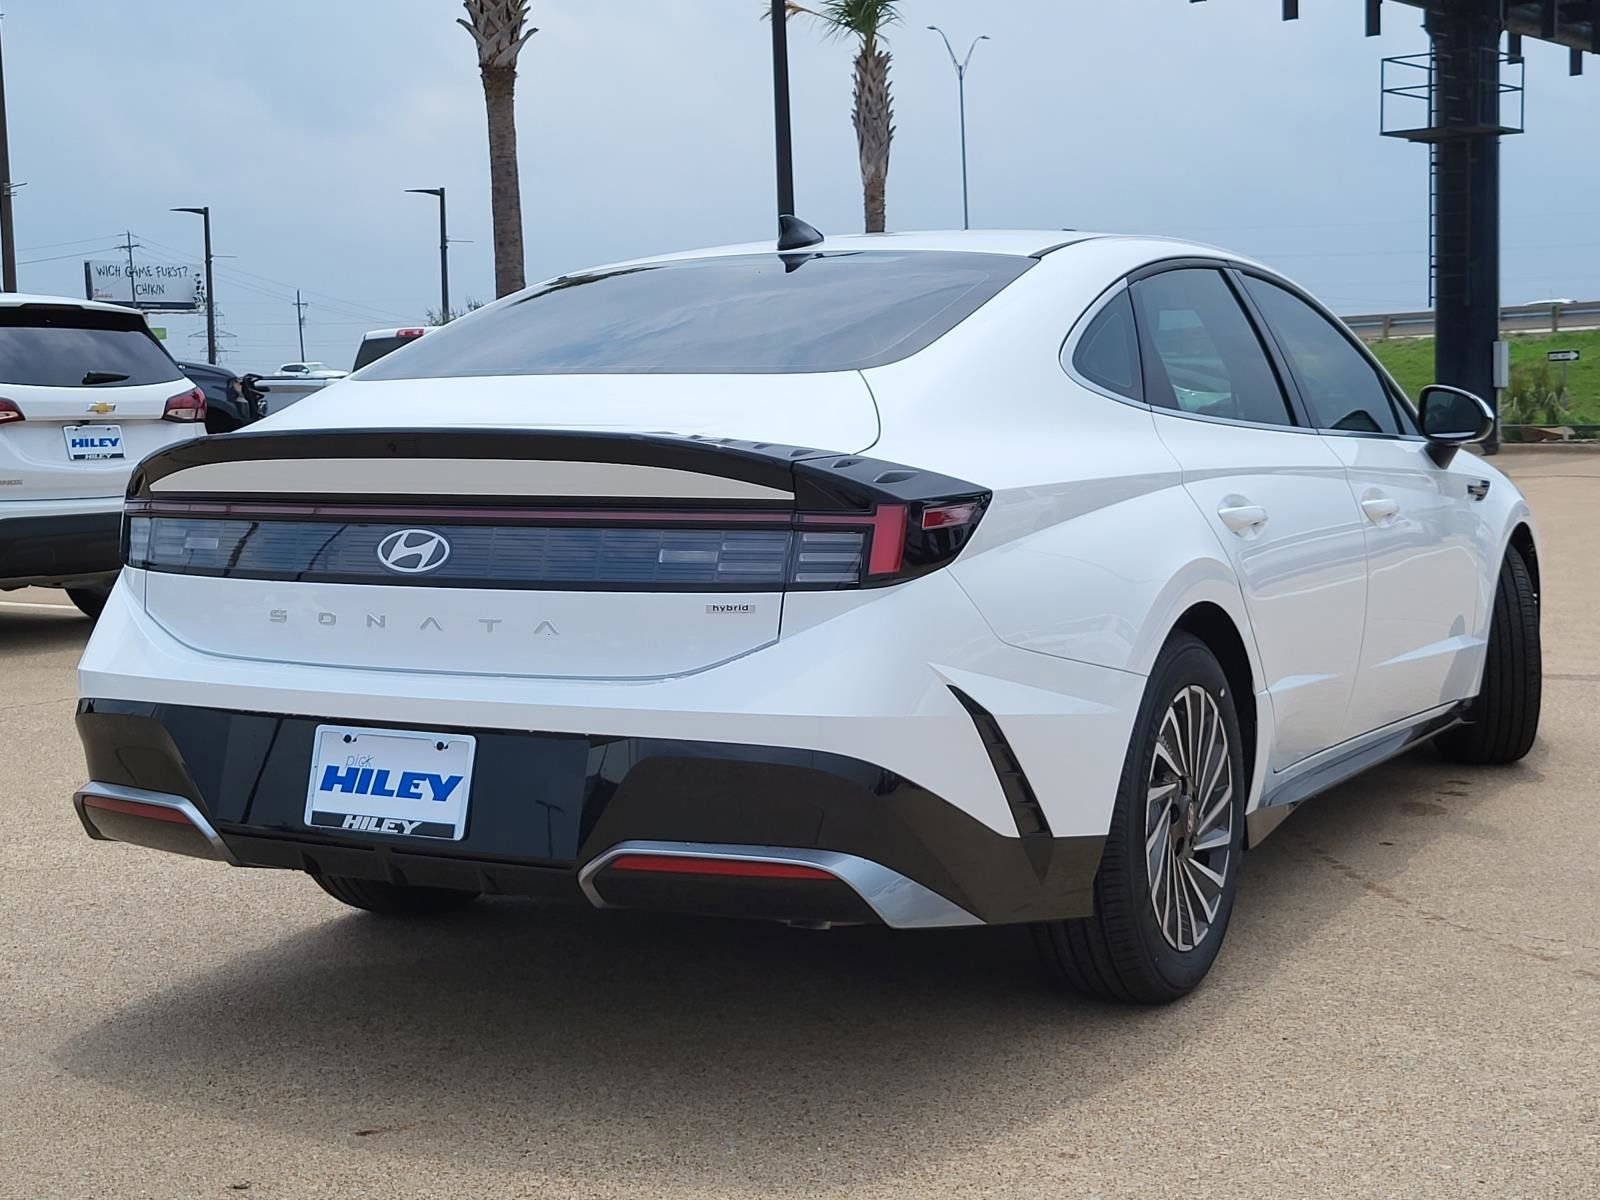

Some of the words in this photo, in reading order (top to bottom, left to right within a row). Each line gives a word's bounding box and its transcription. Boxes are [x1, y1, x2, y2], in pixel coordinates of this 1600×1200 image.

[96, 264, 121, 278] WICH
[156, 265, 188, 279] FURST?
[135, 283, 165, 296] CHIKIN
[71, 437, 120, 448] HILEY
[712, 604, 749, 612] hybrid
[269, 608, 560, 636] SONATA
[320, 765, 464, 802] HILEY
[342, 814, 424, 835] HILEY
